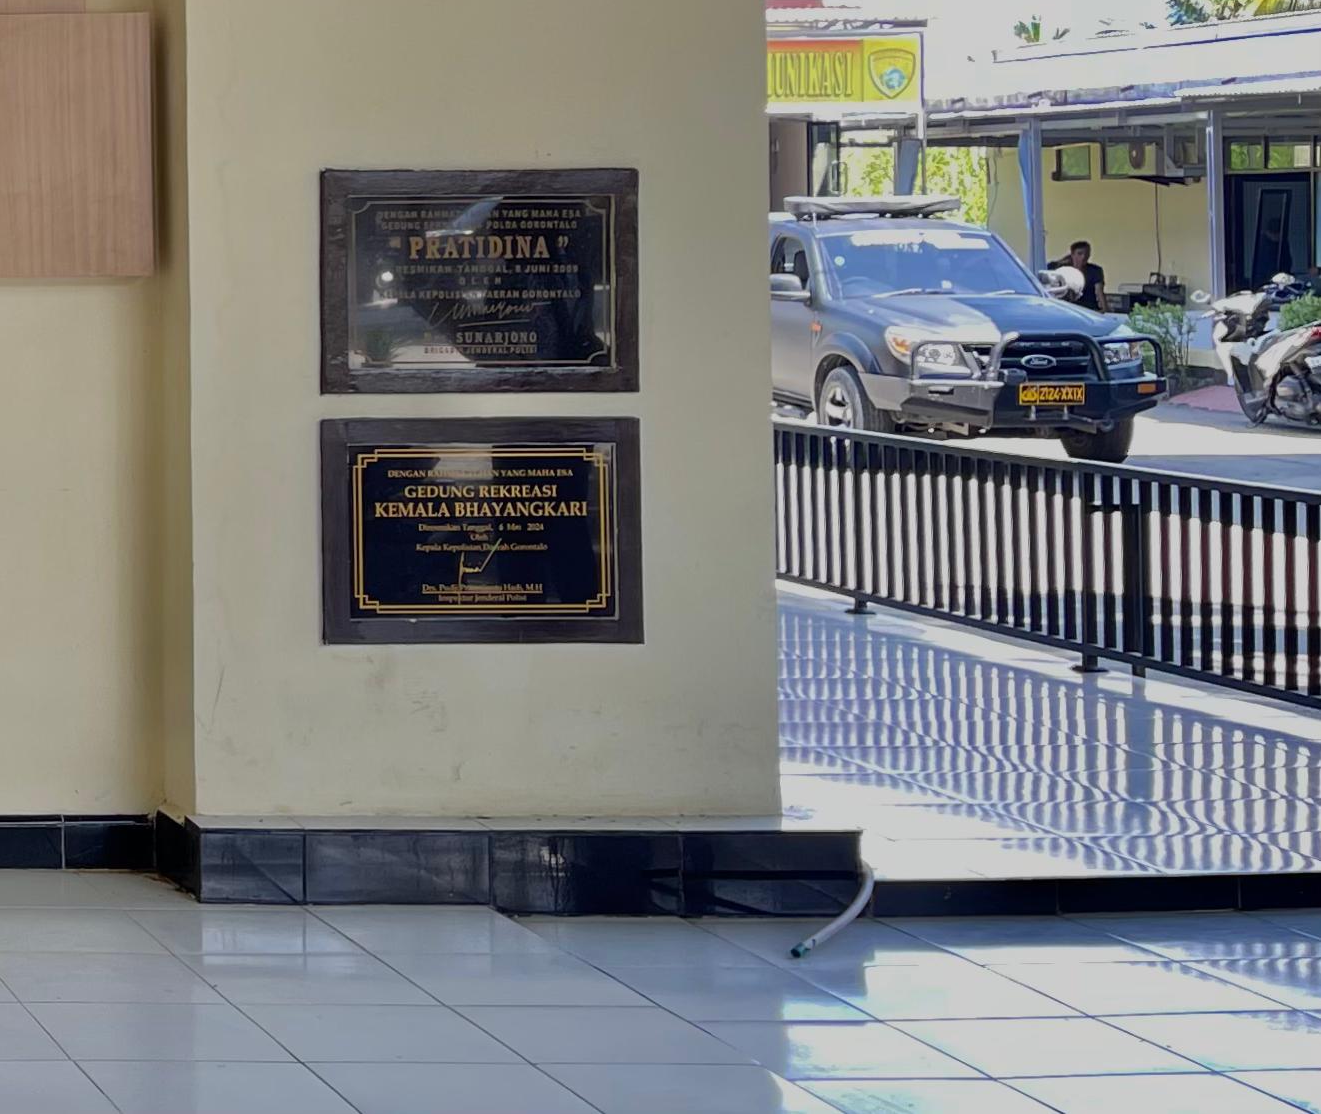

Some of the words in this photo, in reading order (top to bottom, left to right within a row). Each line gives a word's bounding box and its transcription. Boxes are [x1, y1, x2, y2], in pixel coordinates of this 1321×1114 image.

[502, 209, 528, 218] YANG
[562, 209, 582, 218] ESA
[486, 220, 517, 229] POLDA
[520, 220, 578, 229] GORONTALO
[409, 235, 550, 259] PRATIDINA
[524, 264, 551, 274] JUNI
[419, 290, 478, 299] KEPOLIS
[456, 331, 537, 346] SUNARJONO
[388, 470, 426, 478] DENGAN
[500, 469, 526, 477] YANG
[528, 469, 555, 477] MAHA
[557, 469, 573, 477] ESA
[404, 485, 474, 498] GEDUNG
[479, 484, 557, 498] REKREASI
[374, 502, 450, 518] KEMALA
[455, 501, 588, 517] BHAYANGKARI
[526, 522, 544, 531] 2024
